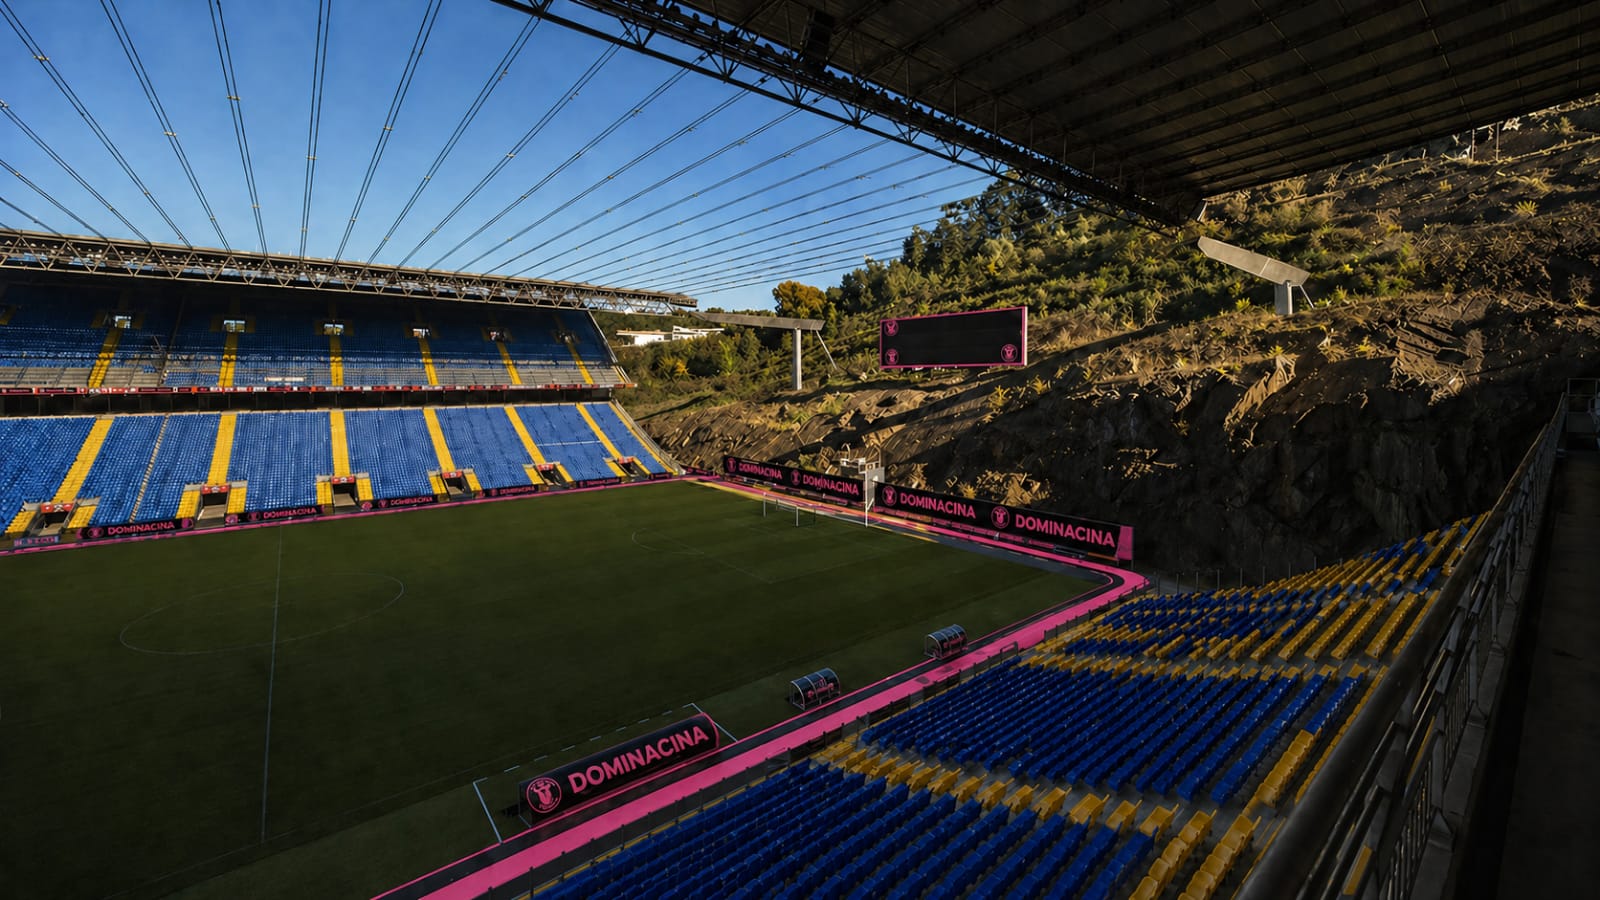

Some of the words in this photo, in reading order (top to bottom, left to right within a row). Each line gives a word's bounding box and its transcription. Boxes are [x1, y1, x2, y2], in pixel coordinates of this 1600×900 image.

[803, 474, 859, 495] DOMINACINA
[900, 492, 977, 519] DOMINACINA
[108, 521, 175, 535] DOMINACINA
[1015, 514, 1116, 548] DOMINACINA
[567, 725, 709, 794] DOMINACINA
